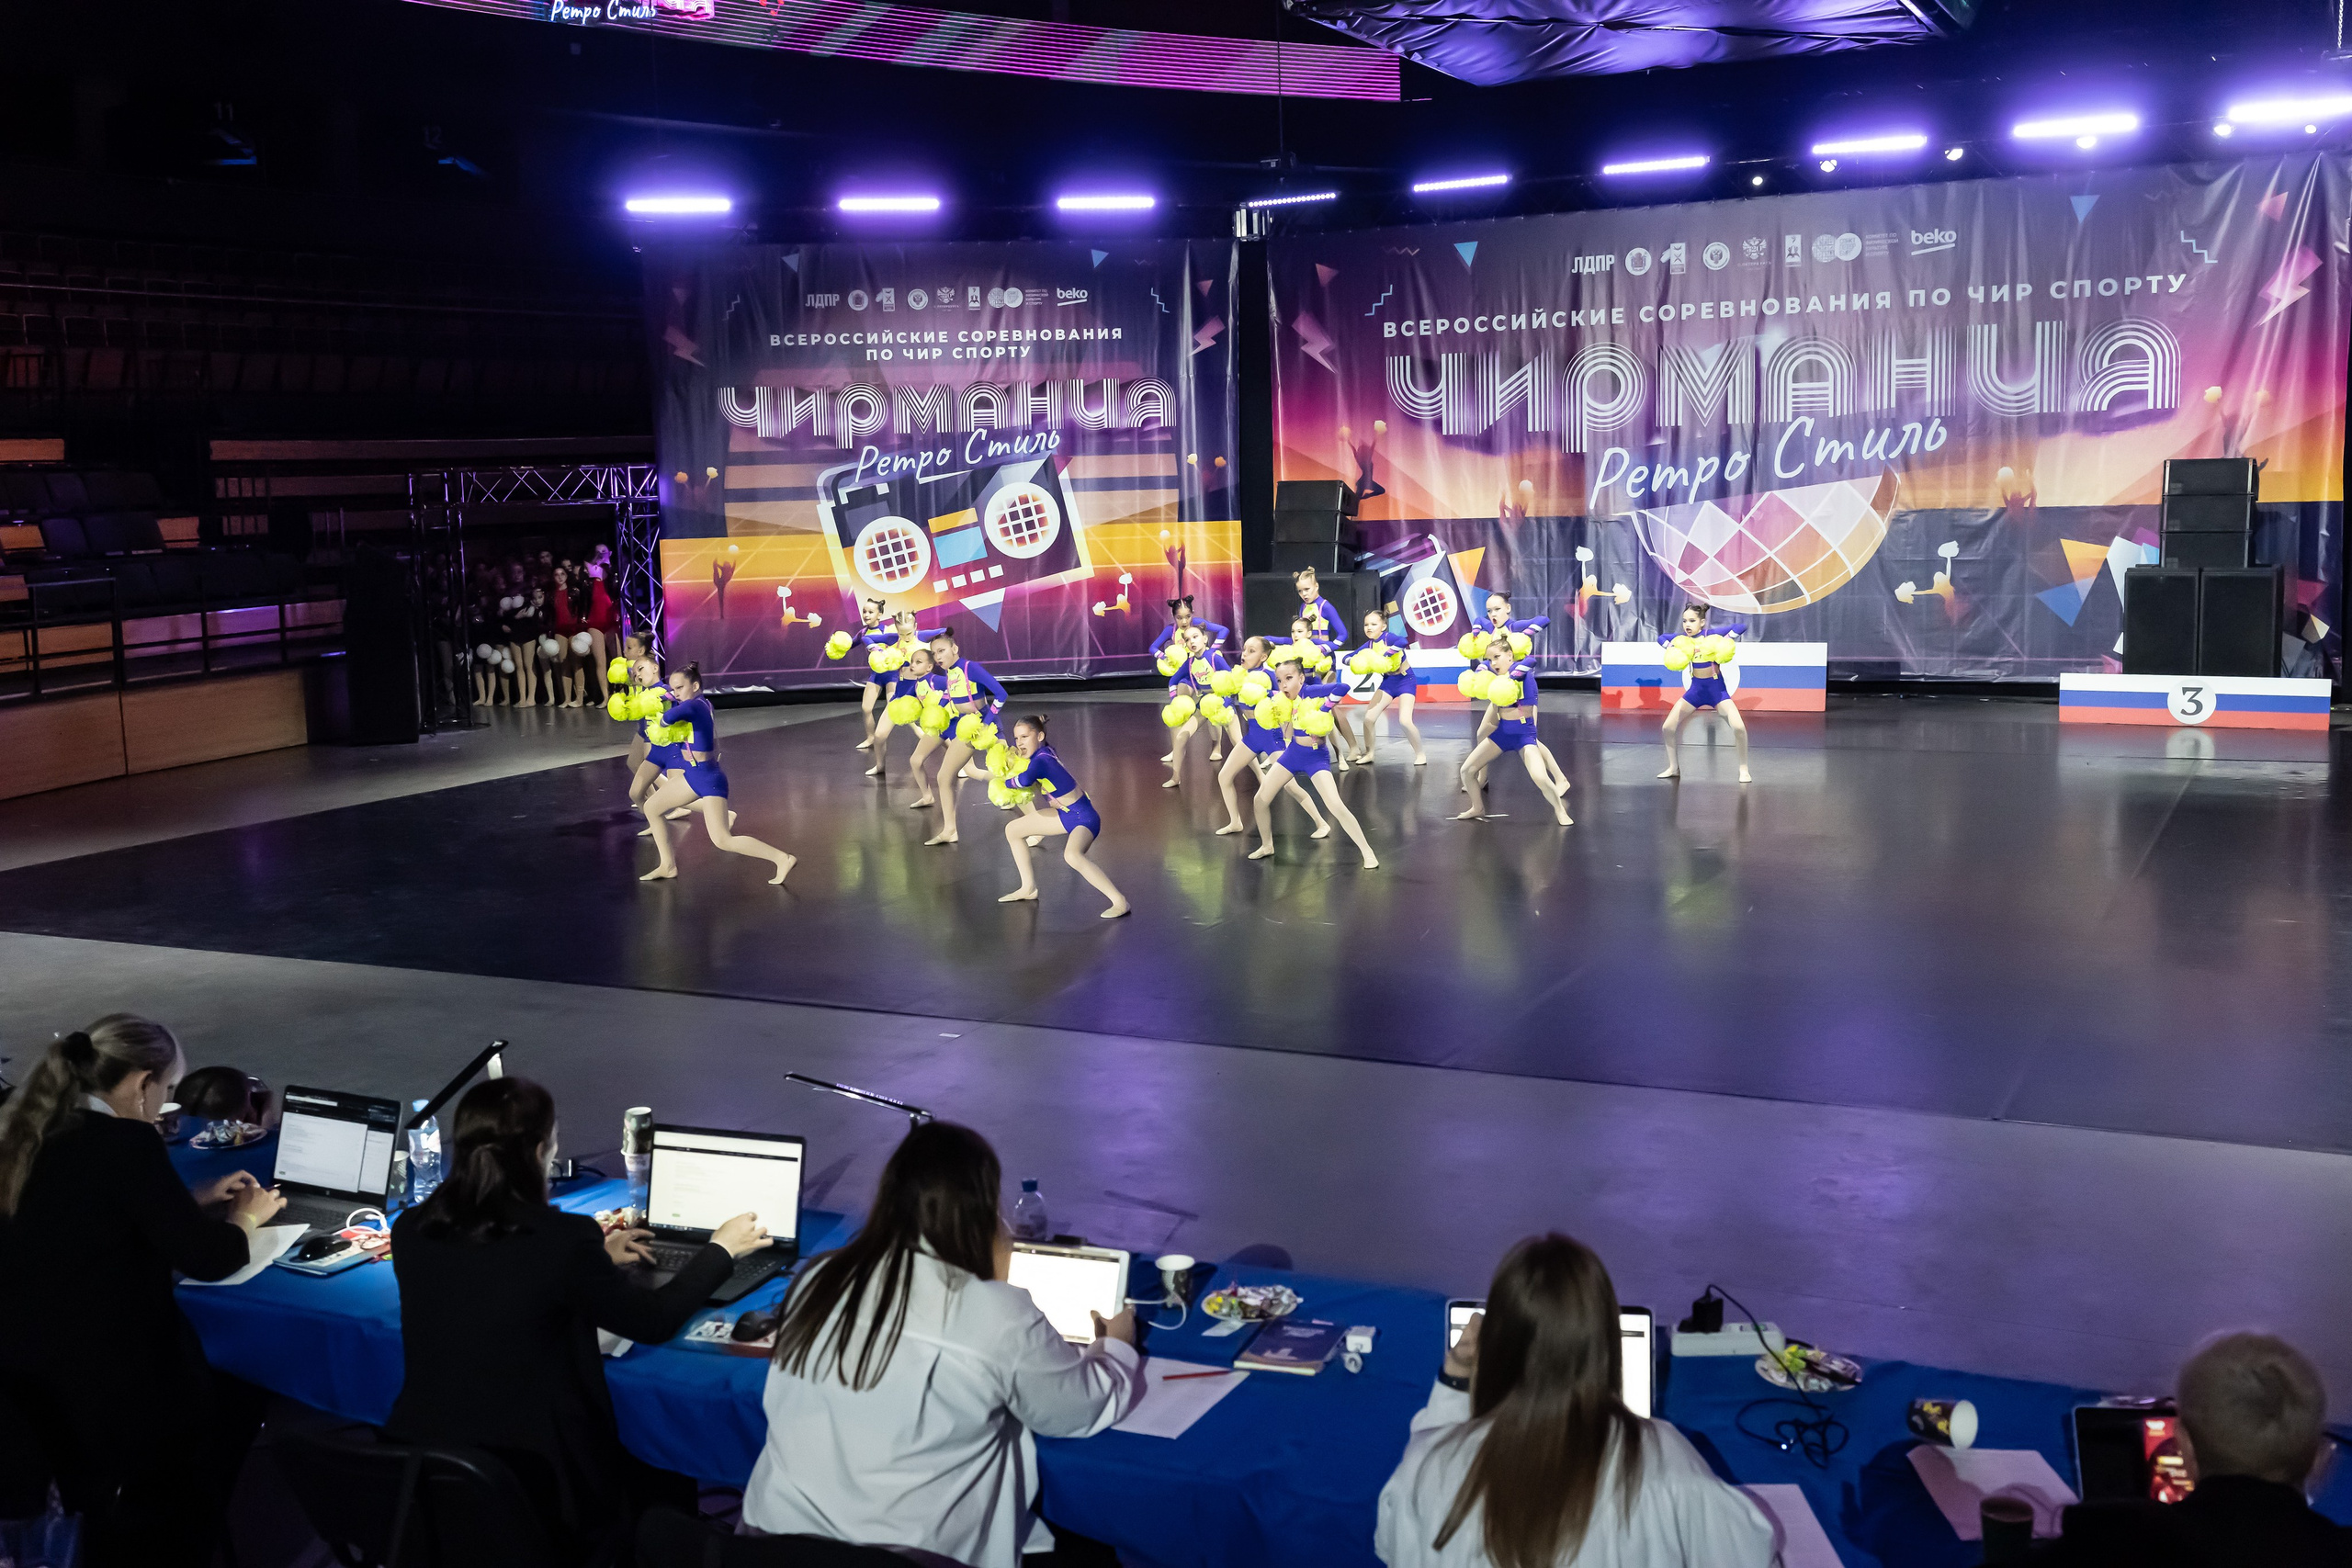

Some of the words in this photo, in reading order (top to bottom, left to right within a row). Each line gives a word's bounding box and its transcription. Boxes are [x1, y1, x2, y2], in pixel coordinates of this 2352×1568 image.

[549, 0, 602, 26] Ретро
[1911, 228, 1957, 245] beko
[1571, 254, 1615, 275] ЛДПР
[805, 294, 841, 309] ЛДПР
[1057, 288, 1088, 299] beko
[1383, 307, 1626, 338] ВСЕРОССИЙСКИЕ
[1639, 291, 1892, 323] СОРЕВНОВАНИЯ
[1908, 288, 1951, 307] ПО
[1969, 283, 2034, 304] ЧИР
[2050, 272, 2189, 300] СПОРТУ
[769, 328, 950, 347] ВСЕРОССИЙСКИЕ
[957, 326, 1124, 344] СОРЕВНОВАНИЯ
[865, 348, 896, 361] ПО
[901, 347, 944, 360] ЧИР
[951, 344, 1032, 360] СПОРТУ
[854, 446, 952, 483] Ретро
[965, 427, 1061, 466] Стиль
[1589, 446, 1752, 510] Ретро
[1773, 415, 1948, 479] Стиль
[2180, 686, 2204, 716] 3
